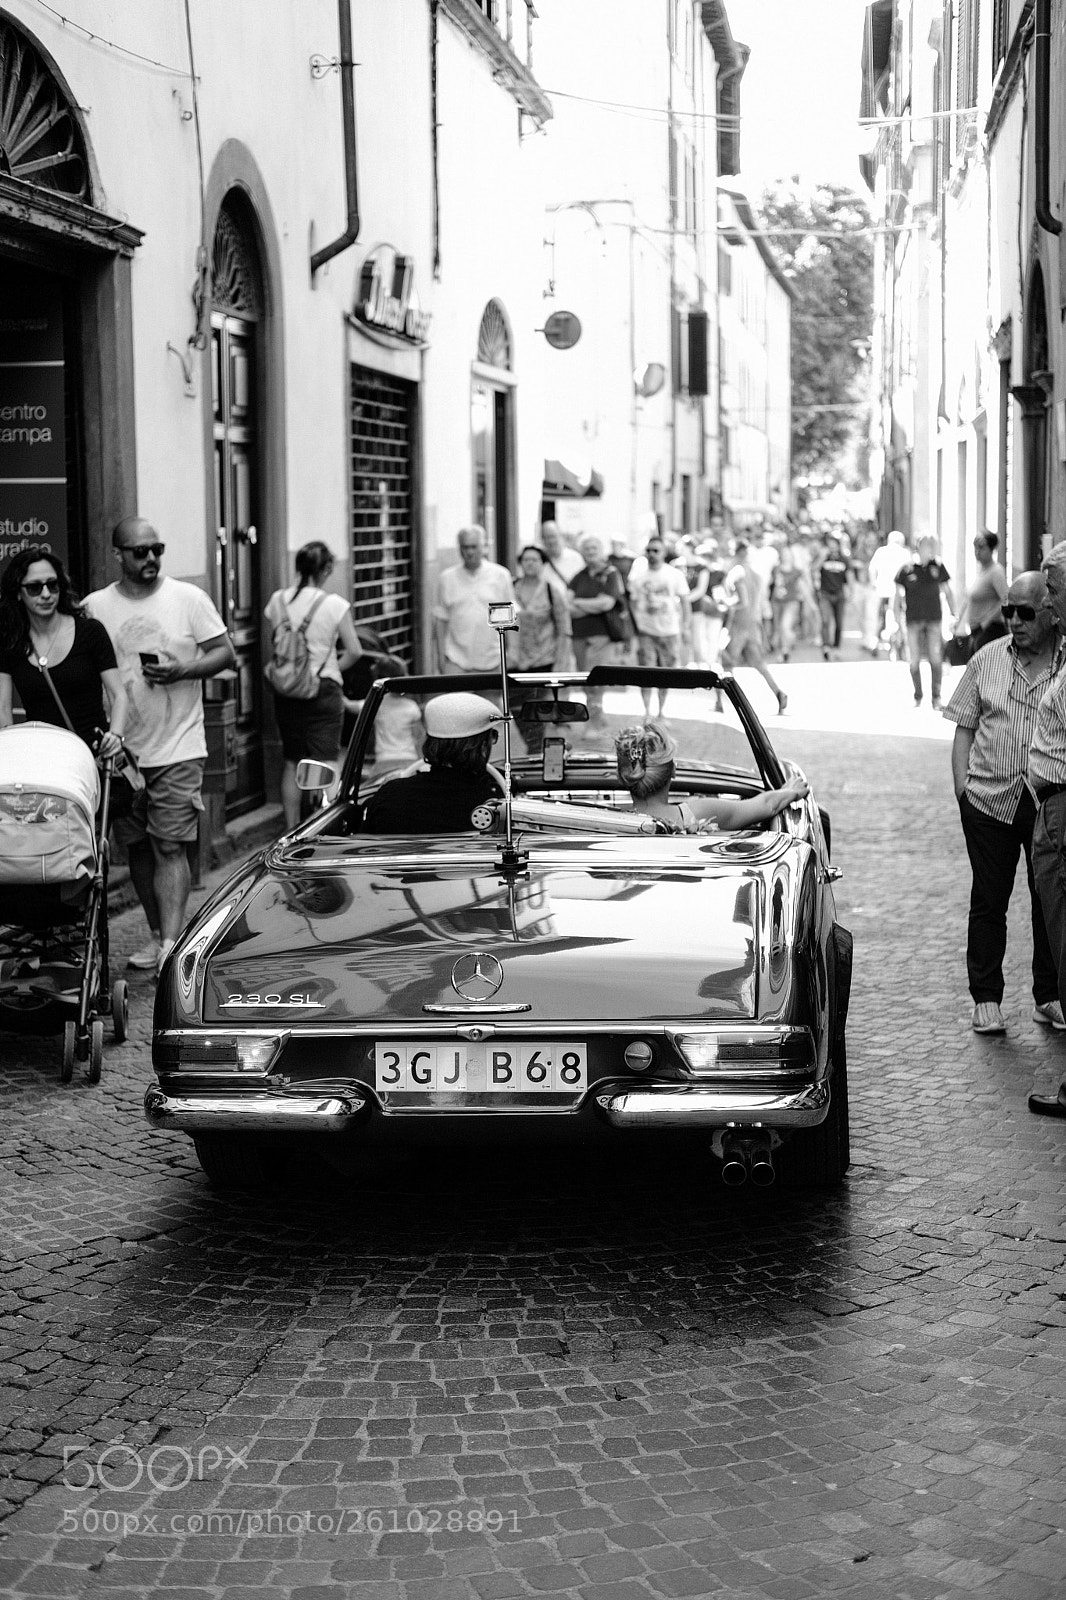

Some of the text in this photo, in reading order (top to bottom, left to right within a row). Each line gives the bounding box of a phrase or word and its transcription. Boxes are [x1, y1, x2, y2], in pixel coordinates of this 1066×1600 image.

[0, 427, 52, 447] ampa
[226, 993, 319, 1005] 230 SL
[381, 1051, 582, 1085] 3GJ B68
